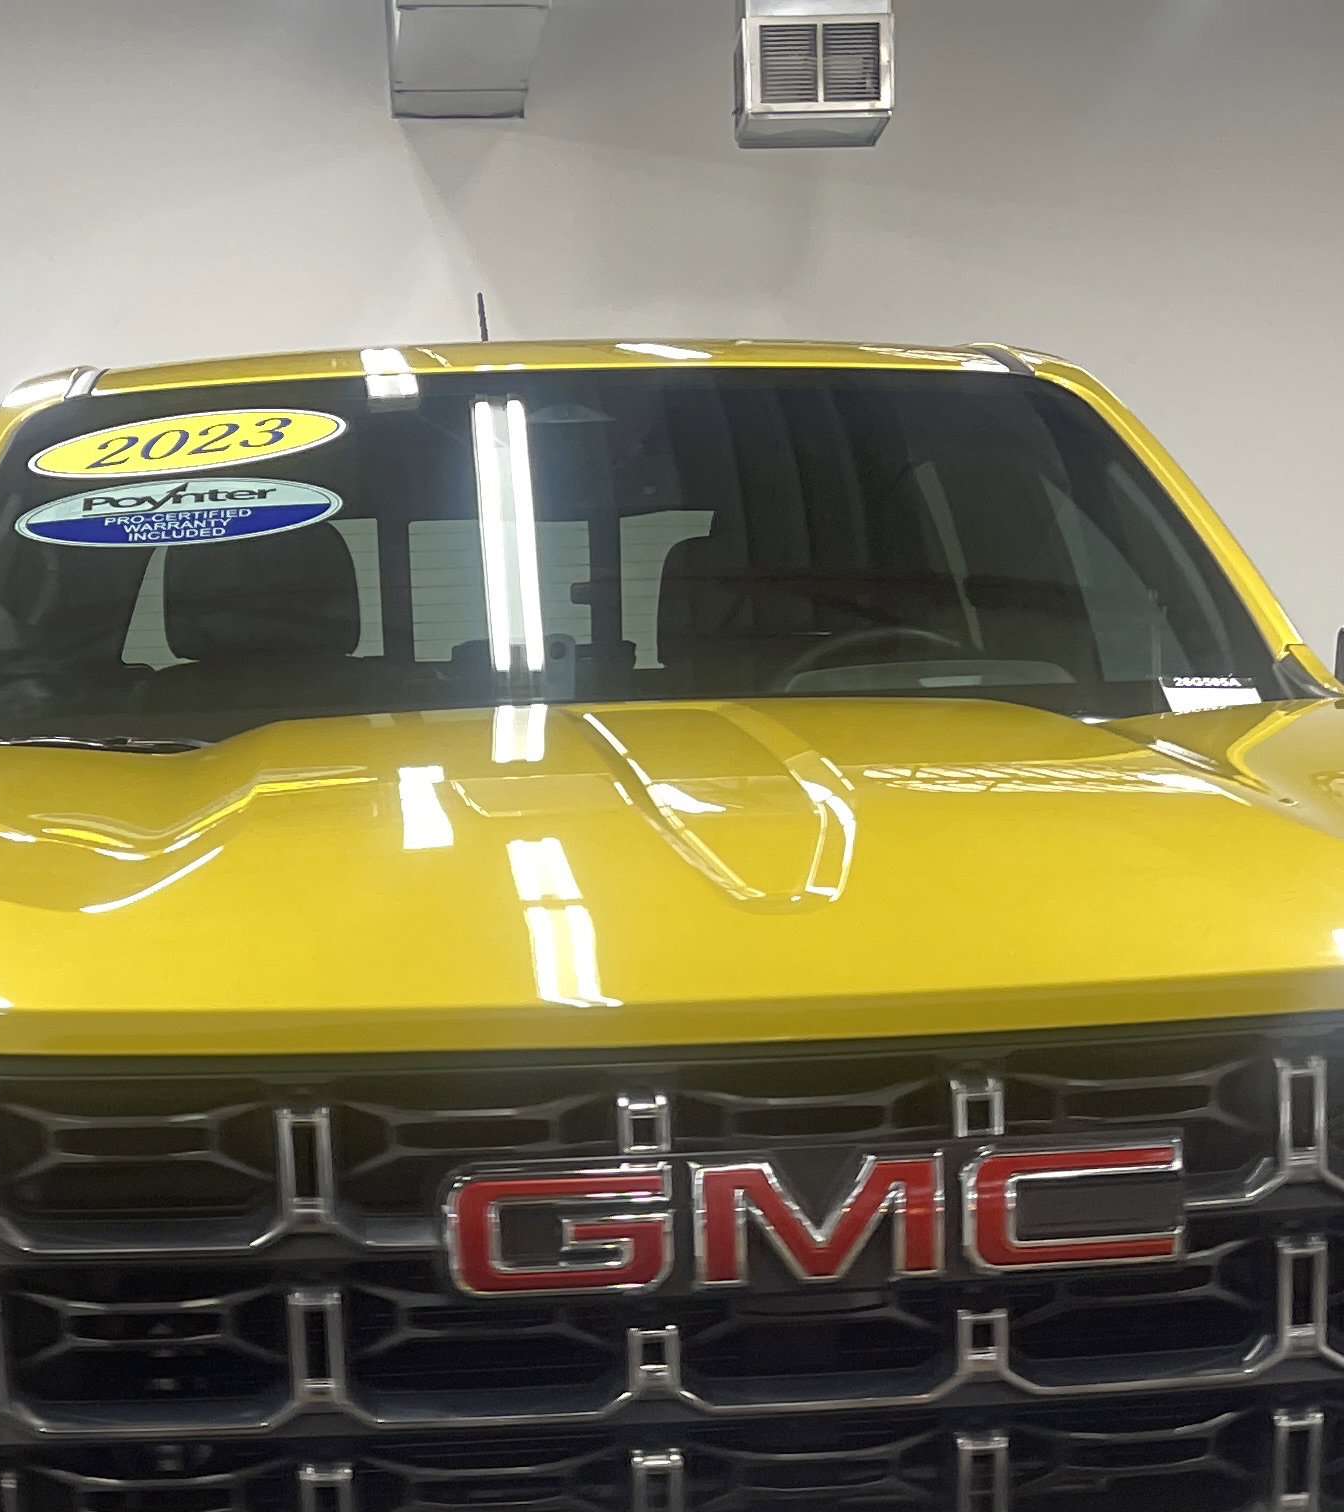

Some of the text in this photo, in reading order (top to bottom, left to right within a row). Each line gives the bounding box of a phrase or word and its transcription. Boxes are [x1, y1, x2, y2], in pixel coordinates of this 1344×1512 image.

[84, 417, 294, 470] 2023
[82, 483, 277, 513] Poynter
[104, 509, 252, 526] PRO-CERTIFIED
[123, 518, 232, 533] WARRANTY
[128, 527, 227, 542] INCLUDED
[446, 1138, 1185, 1297] GMC
